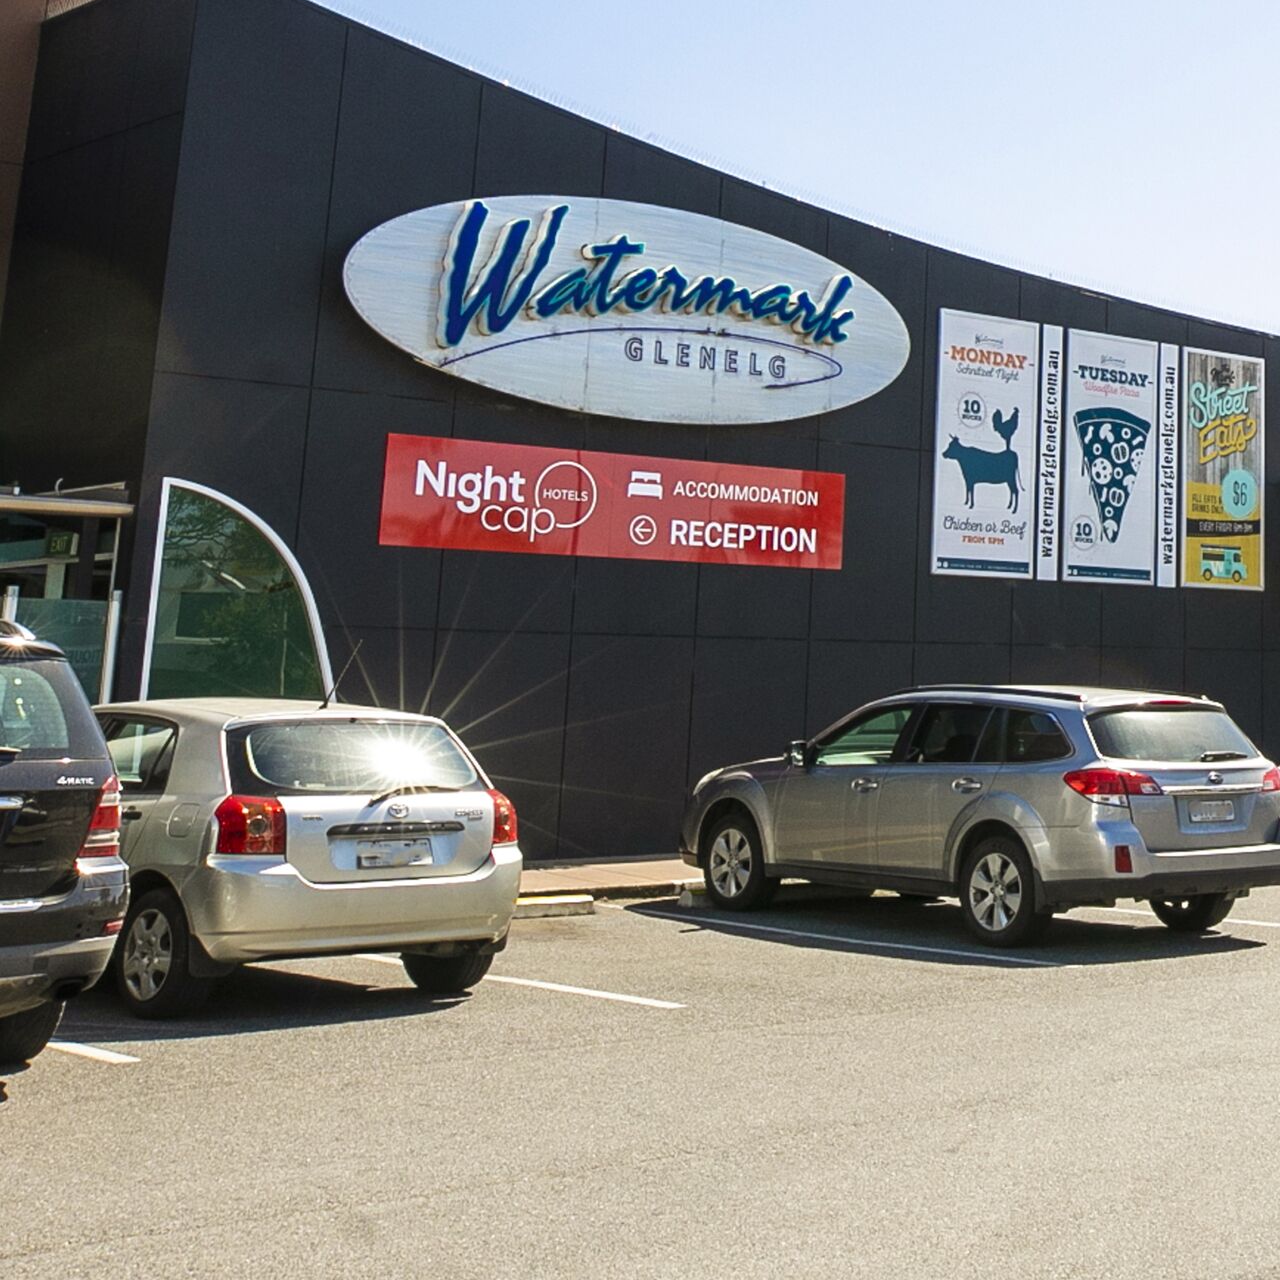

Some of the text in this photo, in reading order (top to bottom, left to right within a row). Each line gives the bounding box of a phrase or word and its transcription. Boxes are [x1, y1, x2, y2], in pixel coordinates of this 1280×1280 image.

[438, 201, 855, 347] Watermark
[624, 337, 787, 380] GLENELG
[963, 399, 982, 415] 10
[1190, 381, 1258, 429] Street
[1040, 349, 1061, 558] watermarkglenelg.com.au
[1199, 414, 1257, 464] Eats
[1161, 366, 1177, 565] watermarkglenelg.com.au
[415, 459, 526, 514] Night
[542, 487, 589, 505] HOTELS
[672, 480, 820, 508] ACCOMMODATION
[1232, 480, 1248, 506] $6
[480, 503, 557, 543] cap
[670, 521, 817, 554] RECEPTION
[943, 514, 1027, 540] Chicken or Beef
[1076, 523, 1093, 537] 10
[50, 536, 69, 552] EXIT
[57, 775, 95, 785] 4MATIC
